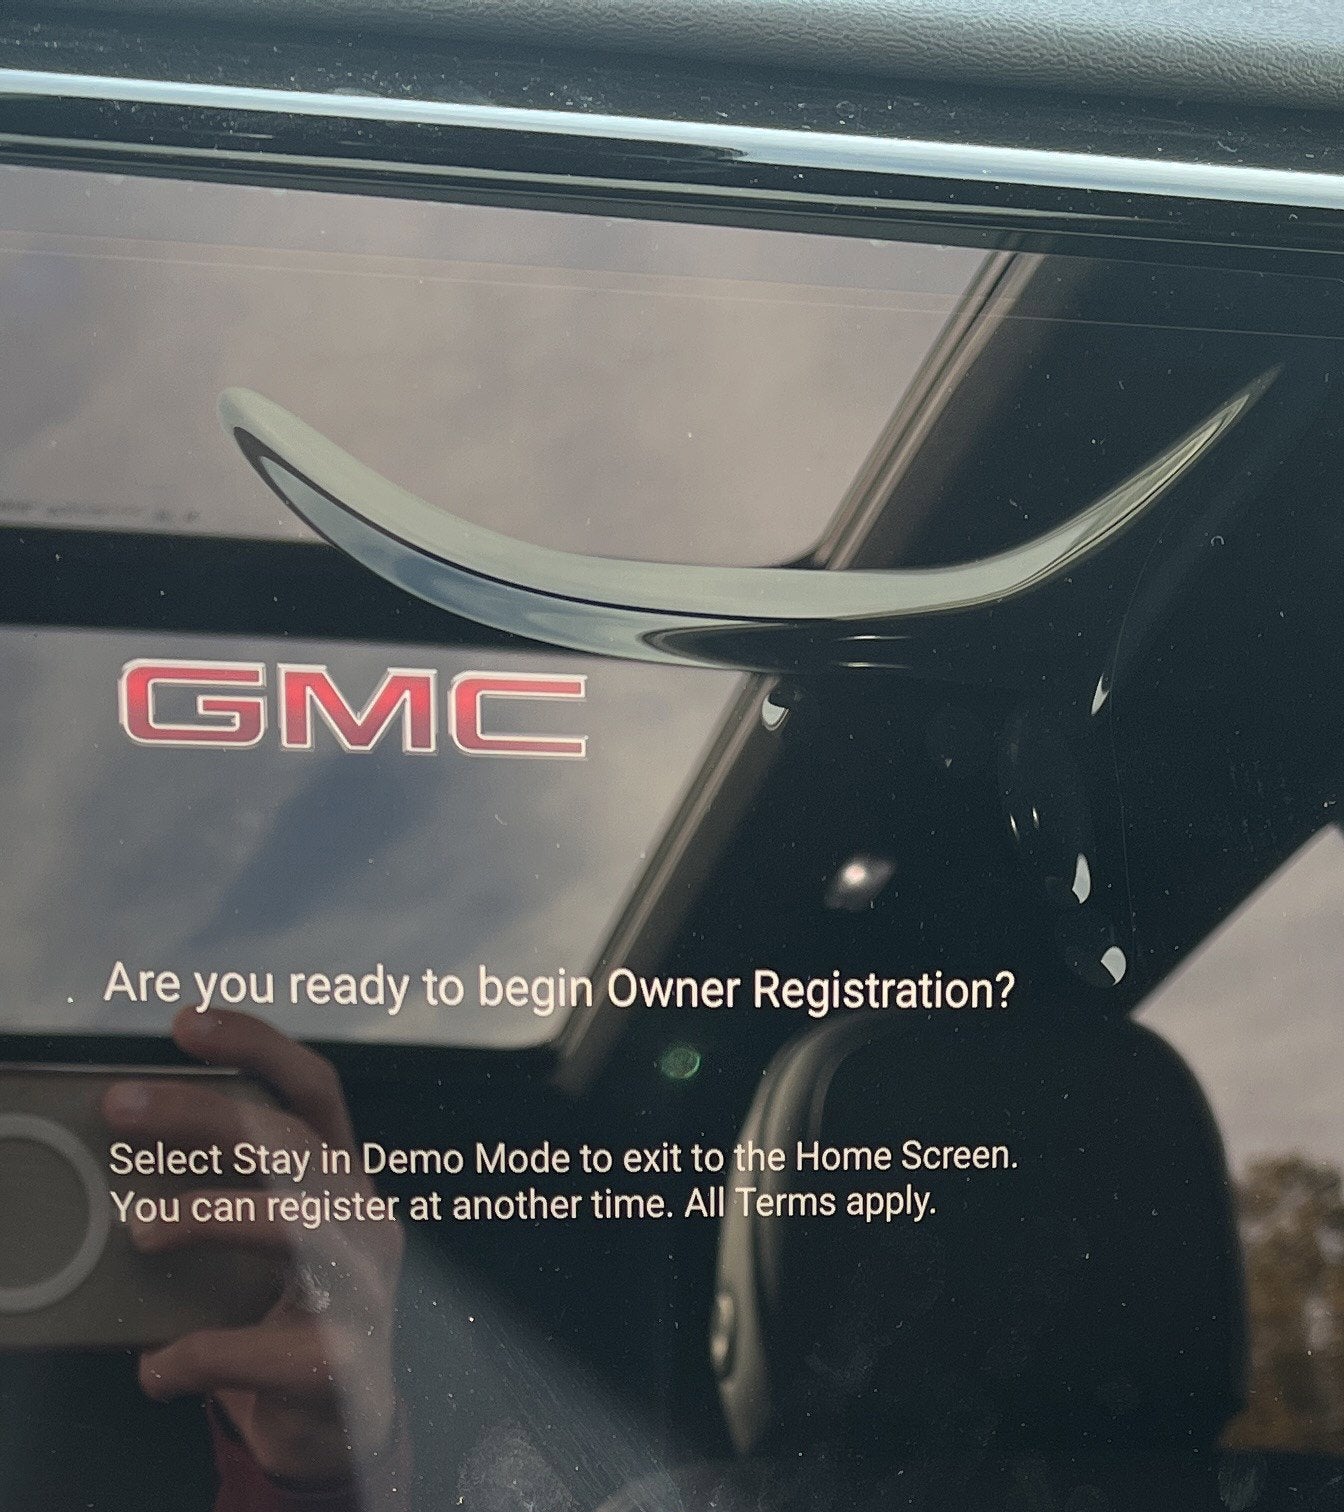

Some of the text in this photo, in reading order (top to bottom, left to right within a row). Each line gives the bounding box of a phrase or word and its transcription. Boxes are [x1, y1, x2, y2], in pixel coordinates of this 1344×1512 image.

[118, 657, 588, 761] GMC
[103, 961, 1016, 1018] Are you ready to begin Owner Registration?
[109, 1139, 1019, 1183] Select Stay in Demo Mode to exit to the Home Screen.
[110, 1183, 937, 1230] You can register at another time. All Terms apply.
